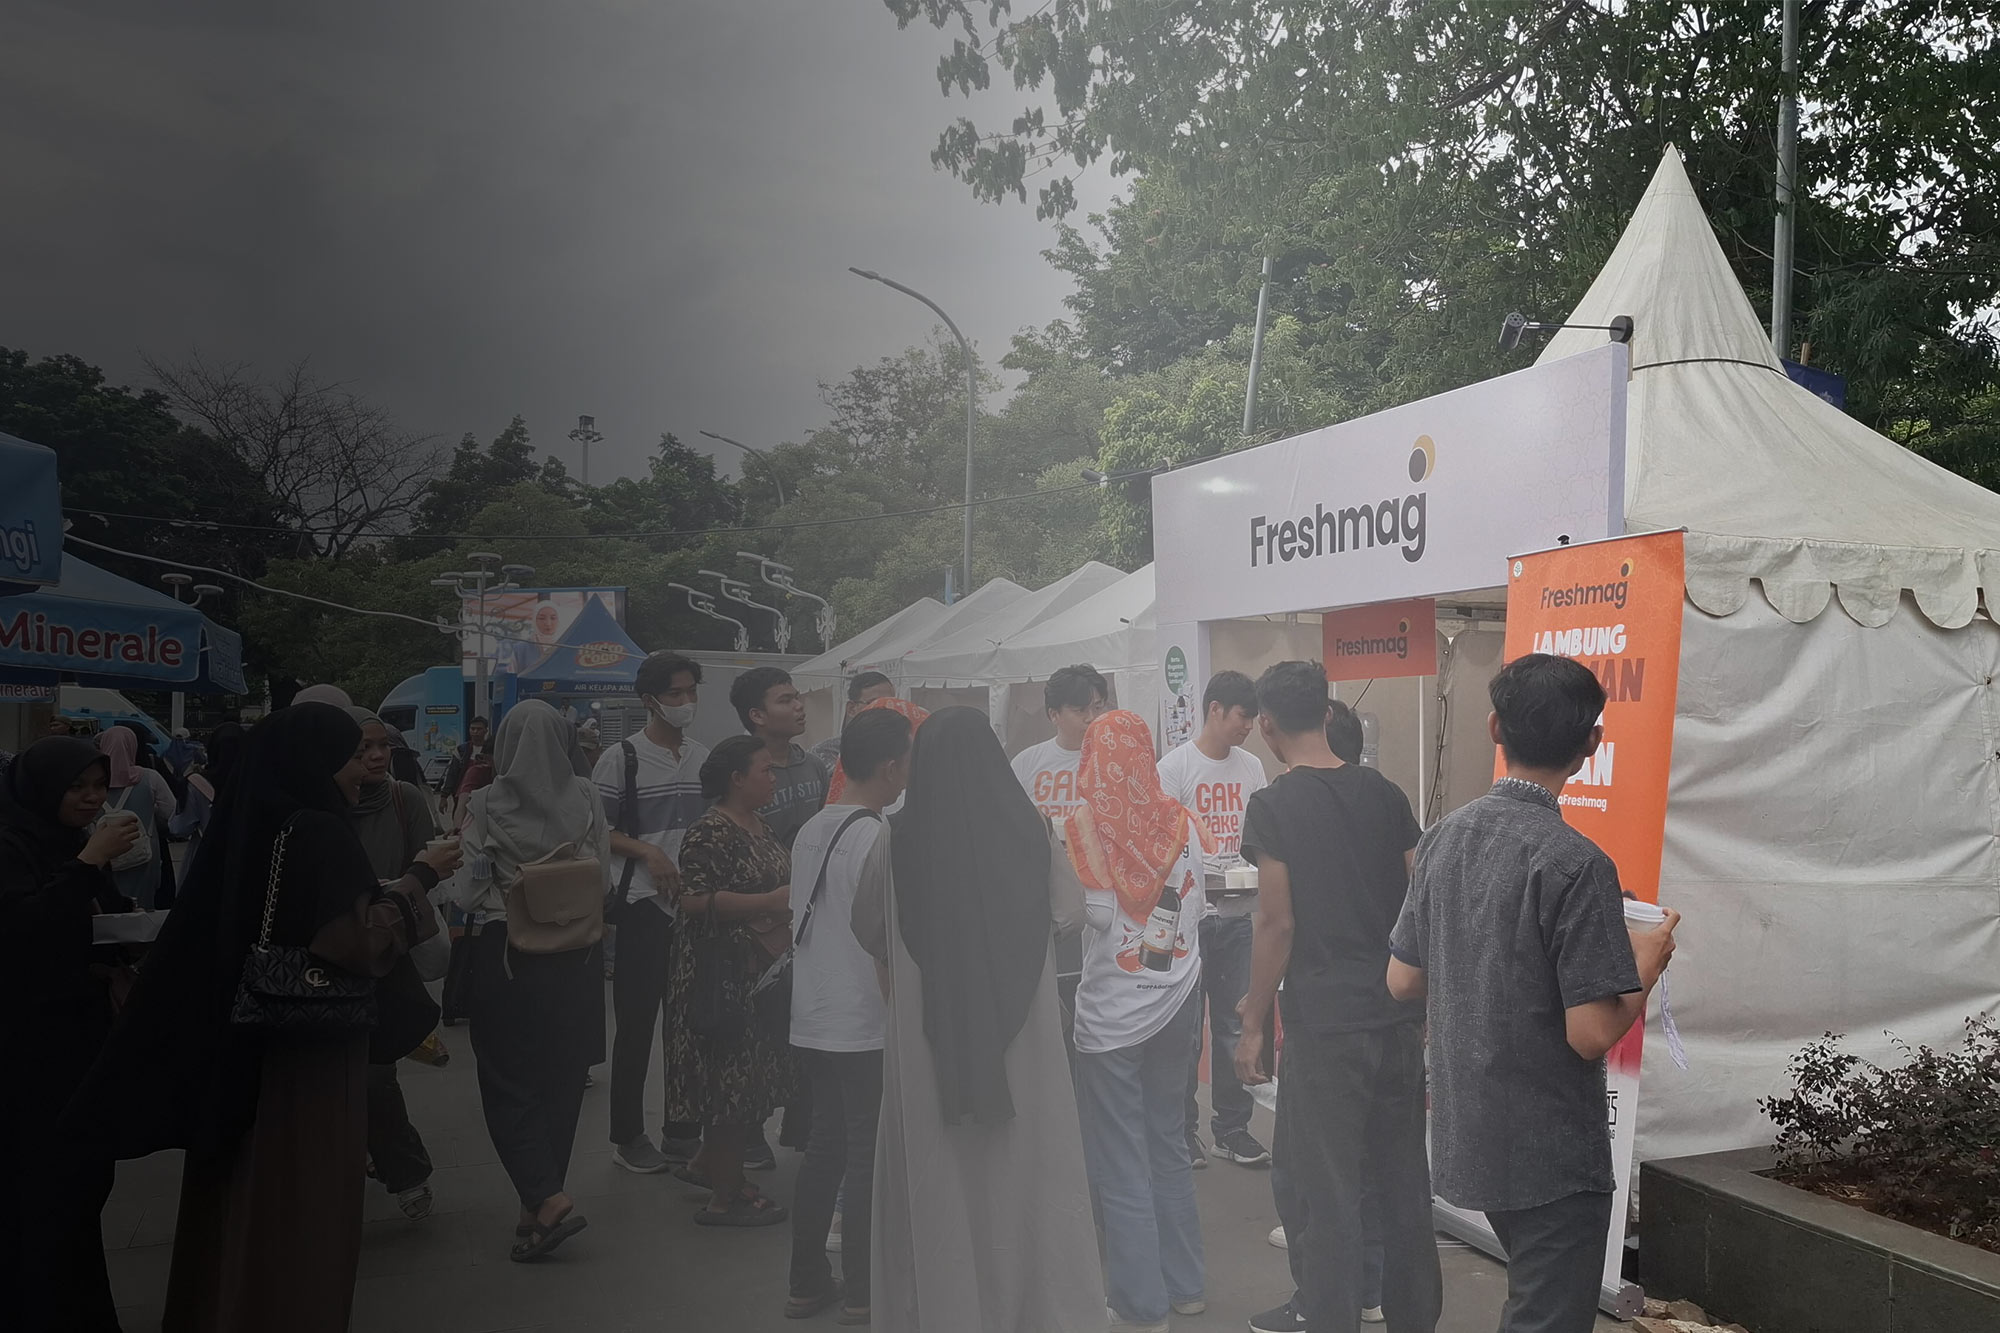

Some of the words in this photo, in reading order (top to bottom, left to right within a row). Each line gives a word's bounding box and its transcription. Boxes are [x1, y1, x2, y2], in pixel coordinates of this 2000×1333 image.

[1250, 492, 1427, 567] Freshmag
[1540, 580, 1628, 609] Freshmag
[0, 610, 183, 667] Minerale
[1336, 636, 1408, 659] Freshmag
[1533, 623, 1627, 657] LAMBUNG
[0, 683, 51, 697] inerale
[1196, 783, 1243, 813] GAK
